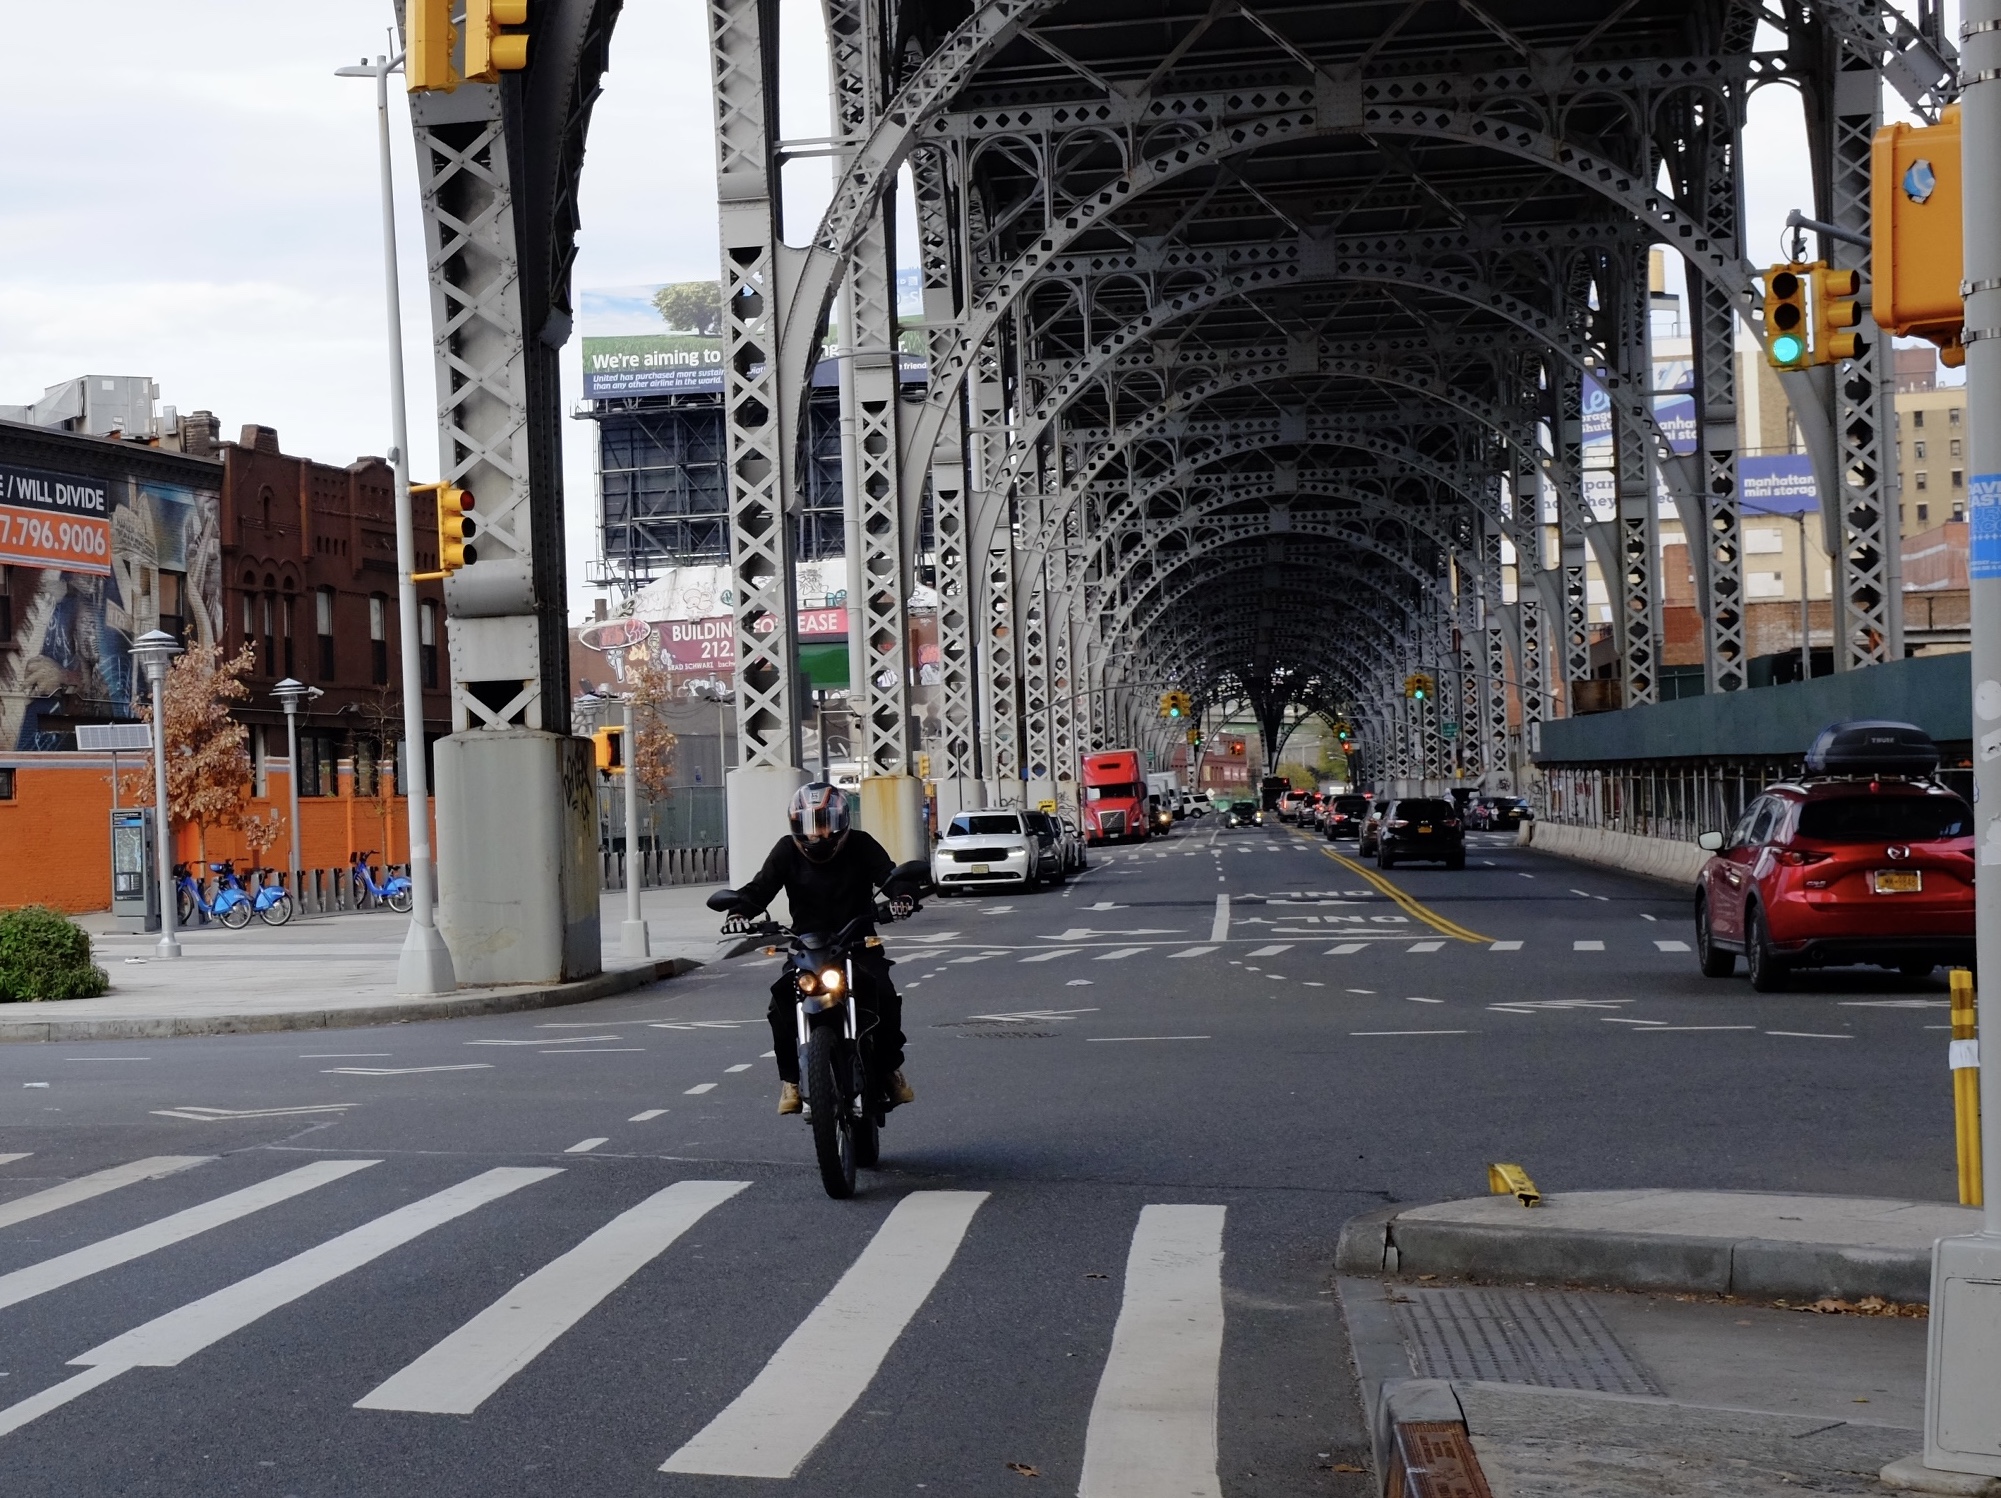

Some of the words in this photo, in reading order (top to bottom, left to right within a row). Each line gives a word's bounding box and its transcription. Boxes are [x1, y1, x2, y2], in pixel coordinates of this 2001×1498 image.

[592, 353, 640, 369] We're
[644, 350, 700, 366] aiming
[703, 349, 721, 363] to
[593, 374, 618, 383] United
[620, 373, 634, 381] has
[635, 371, 675, 382] purchased
[676, 370, 697, 378] more
[593, 382, 611, 391] than
[612, 382, 627, 390] any
[628, 380, 649, 388] other
[650, 378, 674, 387] airline
[675, 378, 683, 386] in
[684, 377, 697, 386] the
[698, 376, 723, 385] world.
[1658, 414, 1696, 430] anha
[1744, 472, 1815, 487] manhattan
[16, 477, 53, 503] WILL
[55, 483, 105, 511] DIVIDE
[1744, 487, 1771, 497] mini
[1773, 486, 1817, 497] storag
[0, 515, 105, 555] 7.796.9006
[672, 621, 734, 642] BUILDIN
[797, 613, 838, 632] EASE
[701, 641, 734, 659] 212.
[1232, 916, 1409, 925] ONLY
